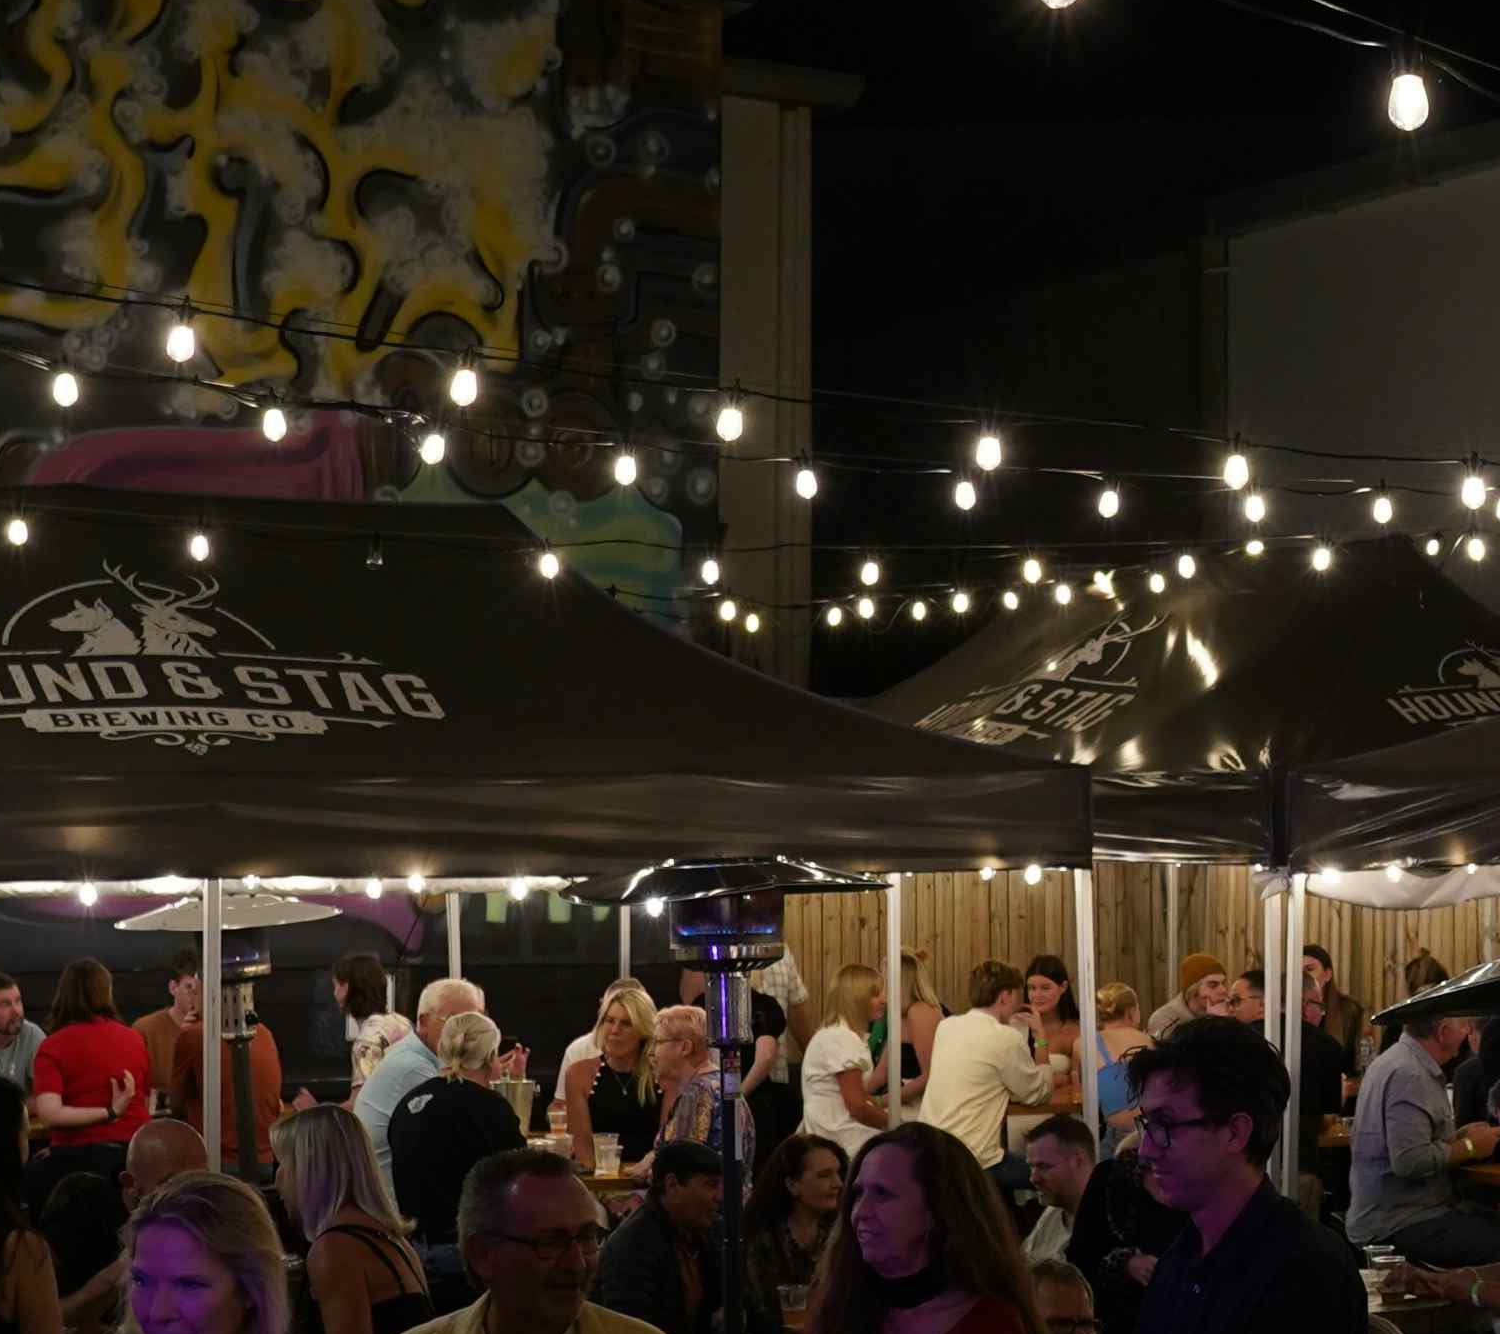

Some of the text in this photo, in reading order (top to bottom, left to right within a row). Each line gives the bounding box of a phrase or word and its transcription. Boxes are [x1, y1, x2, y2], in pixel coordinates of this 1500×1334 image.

[163, 662, 224, 700] &
[236, 665, 446, 720] STAG
[1022, 687, 1139, 733] STAG
[51, 710, 311, 732] BREWING CO.
